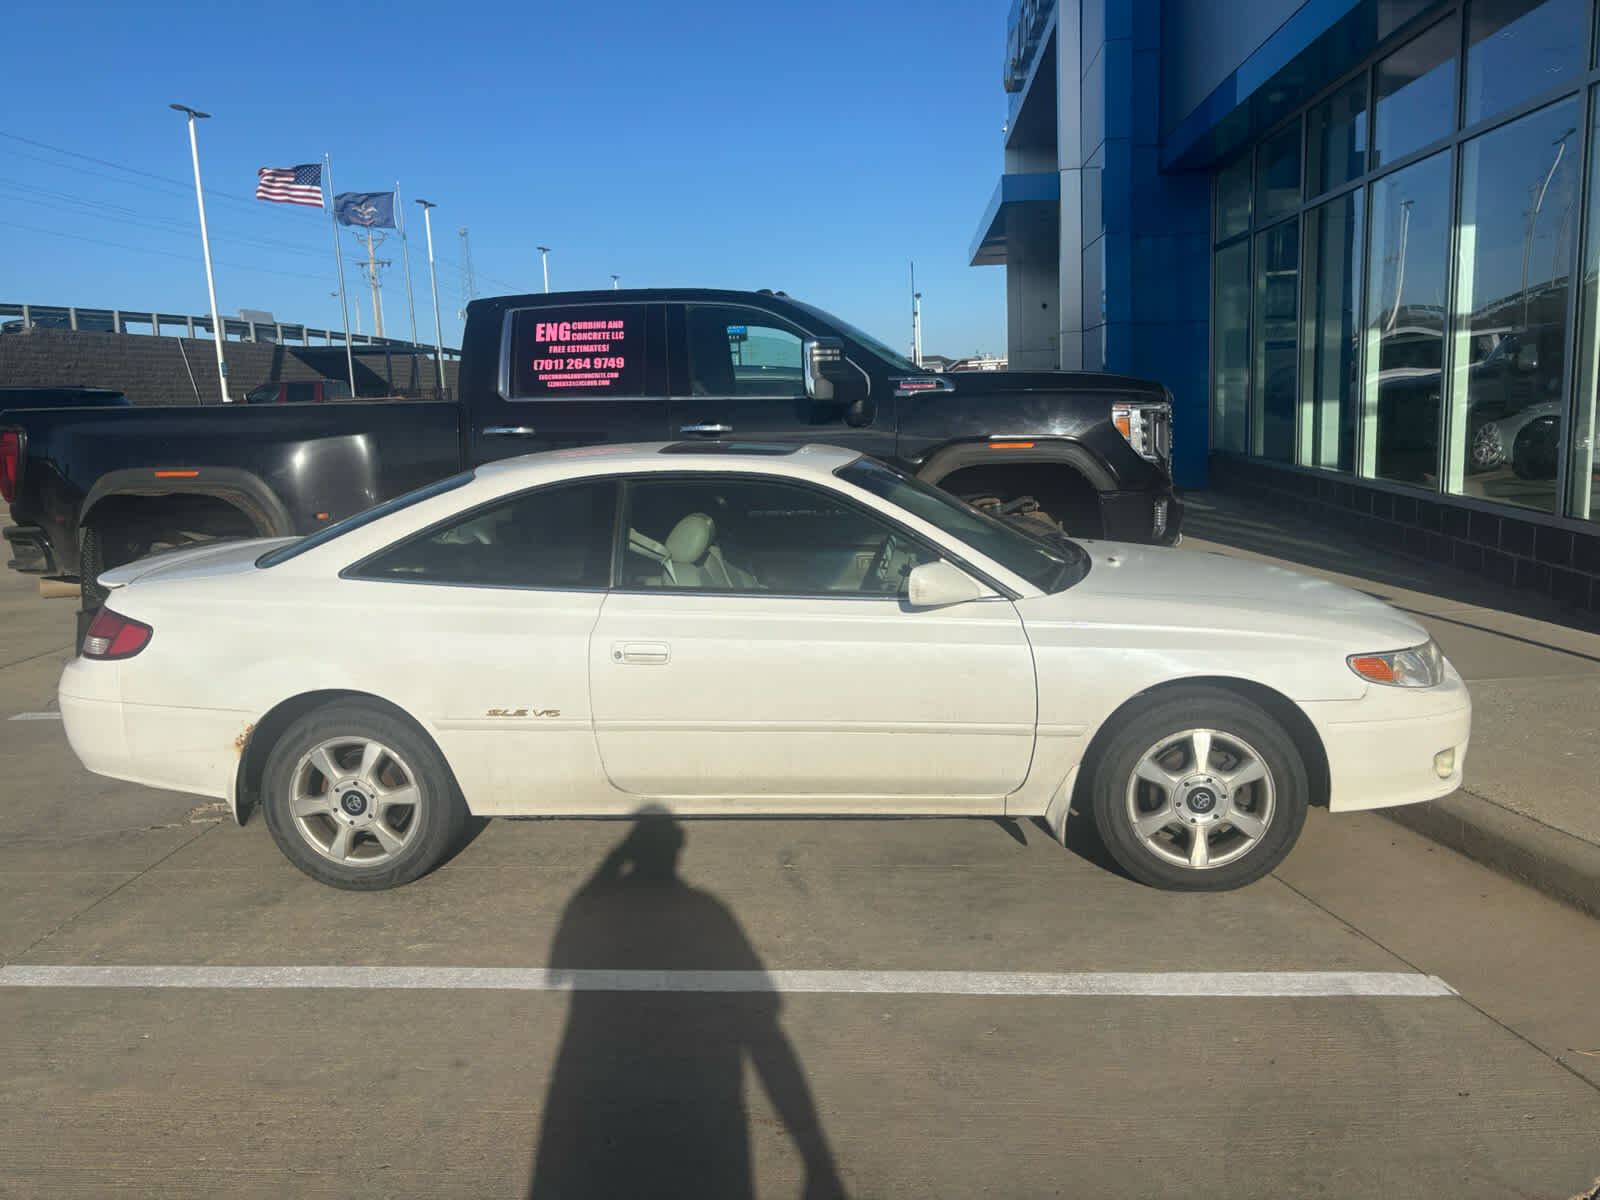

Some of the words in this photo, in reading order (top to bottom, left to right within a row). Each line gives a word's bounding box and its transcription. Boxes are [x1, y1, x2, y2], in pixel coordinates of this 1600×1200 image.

[535, 322, 571, 342] ENG
[572, 321, 606, 330] CURBING
[607, 320, 624, 329] AND
[572, 331, 610, 341] CONCRETE
[611, 331, 624, 340] LLC
[549, 345, 566, 354] FREE
[567, 344, 610, 353] ESTIMATES!
[533, 358, 564, 371] (701)
[566, 358, 591, 370] 264
[593, 357, 625, 369] 9749
